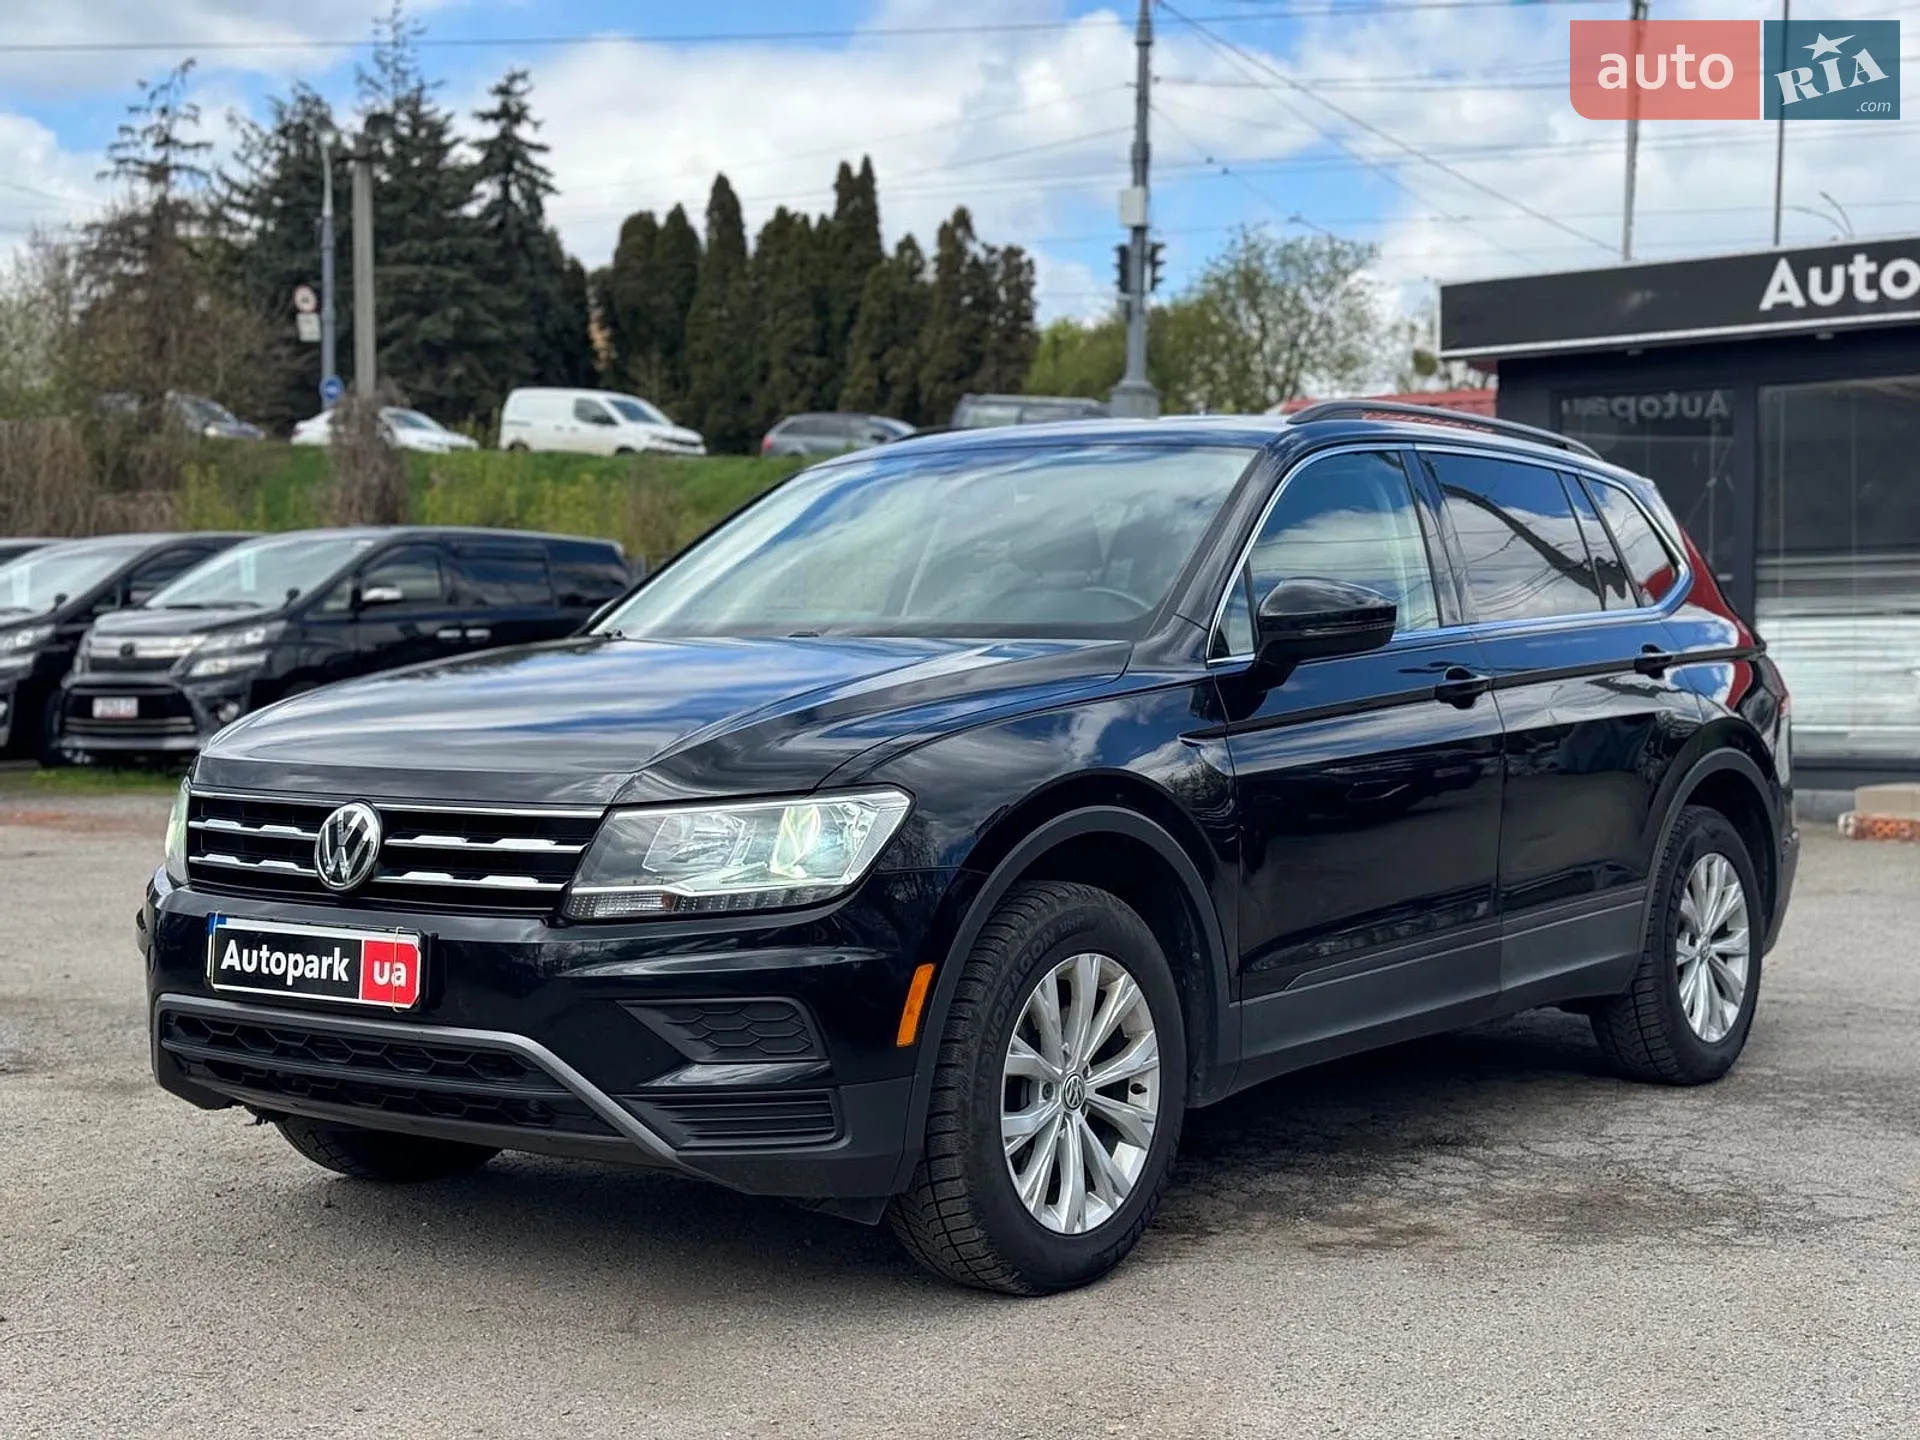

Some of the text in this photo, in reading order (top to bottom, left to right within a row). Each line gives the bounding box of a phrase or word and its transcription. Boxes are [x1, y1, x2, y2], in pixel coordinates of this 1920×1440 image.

[1759, 252, 1920, 311] Auto
[220, 939, 407, 987] Autopark ua
